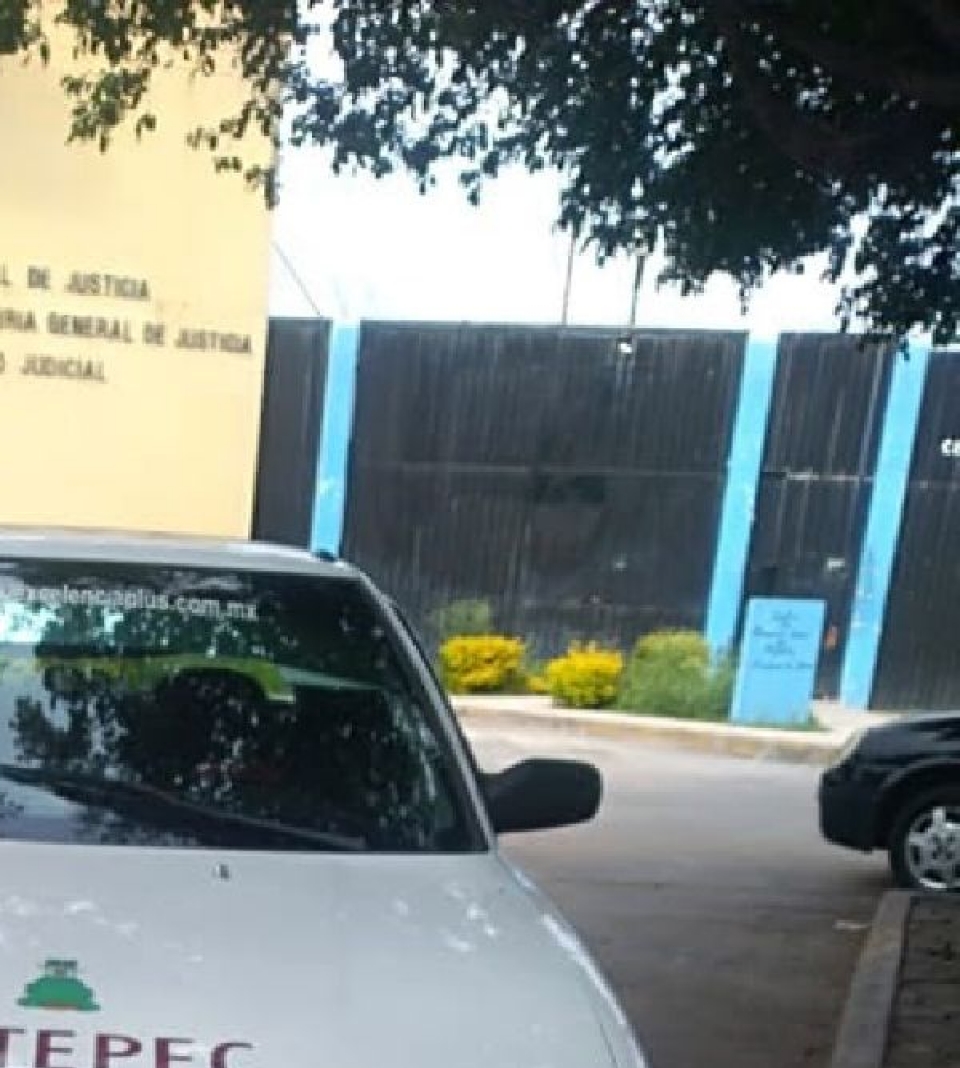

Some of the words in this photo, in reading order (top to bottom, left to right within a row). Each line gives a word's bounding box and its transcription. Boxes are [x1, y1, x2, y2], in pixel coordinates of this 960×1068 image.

[27, 266, 50, 291] DE
[65, 271, 150, 301] JUSTICIA
[47, 311, 132, 344] GENERAL
[143, 321, 165, 346] DE
[175, 328, 251, 354] JUSTICIA
[22, 354, 107, 383] JUDICIAL
